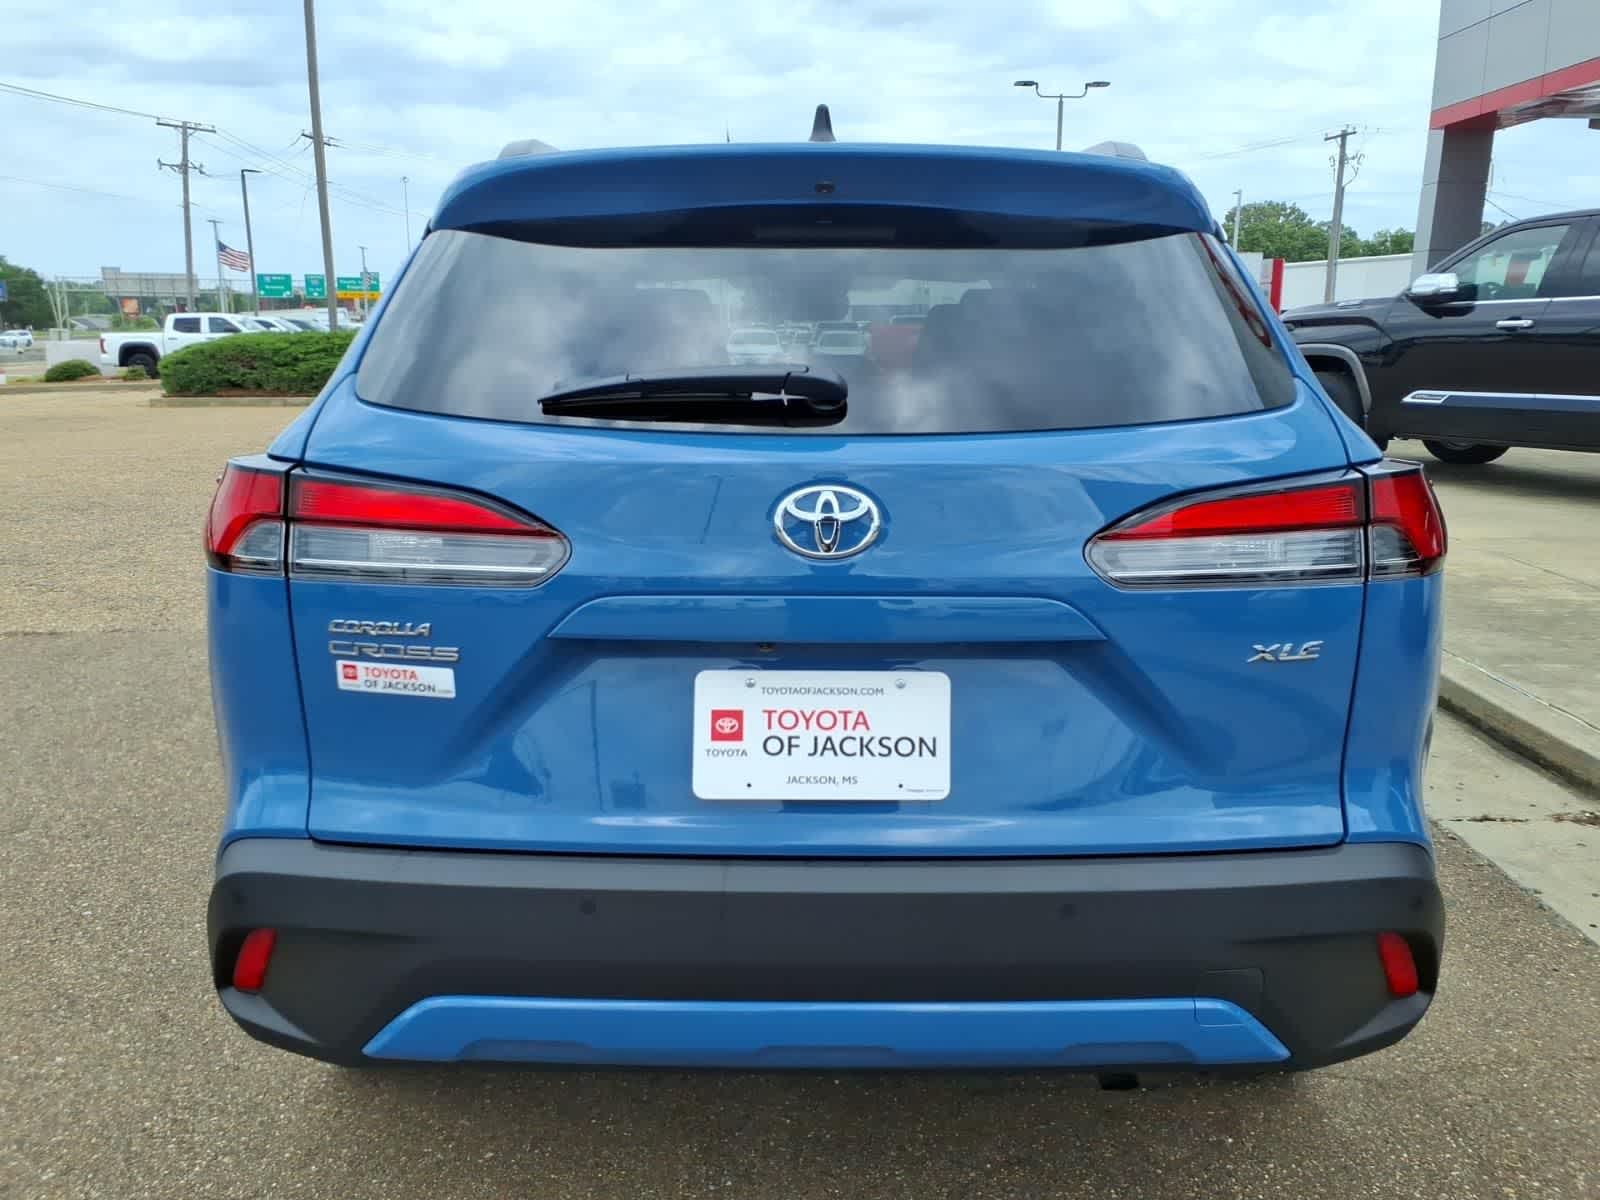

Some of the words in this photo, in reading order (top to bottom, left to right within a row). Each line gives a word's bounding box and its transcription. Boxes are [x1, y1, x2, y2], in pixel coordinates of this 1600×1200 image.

[328, 619, 432, 637] COROLLA
[328, 640, 460, 661] CROSS
[1247, 640, 1324, 662] XLE
[364, 667, 417, 680] TOYOTA
[364, 679, 378, 689] OF
[381, 680, 437, 694] JACKSON
[761, 686, 885, 697] TOYOTAOFJACKSON.COM
[762, 709, 870, 732] TOYOTA
[706, 748, 748, 757] TOYOTA
[762, 736, 801, 757] OF
[807, 736, 937, 758] JACKSON
[785, 776, 839, 787] JACKSON,
[841, 776, 859, 786] MS
